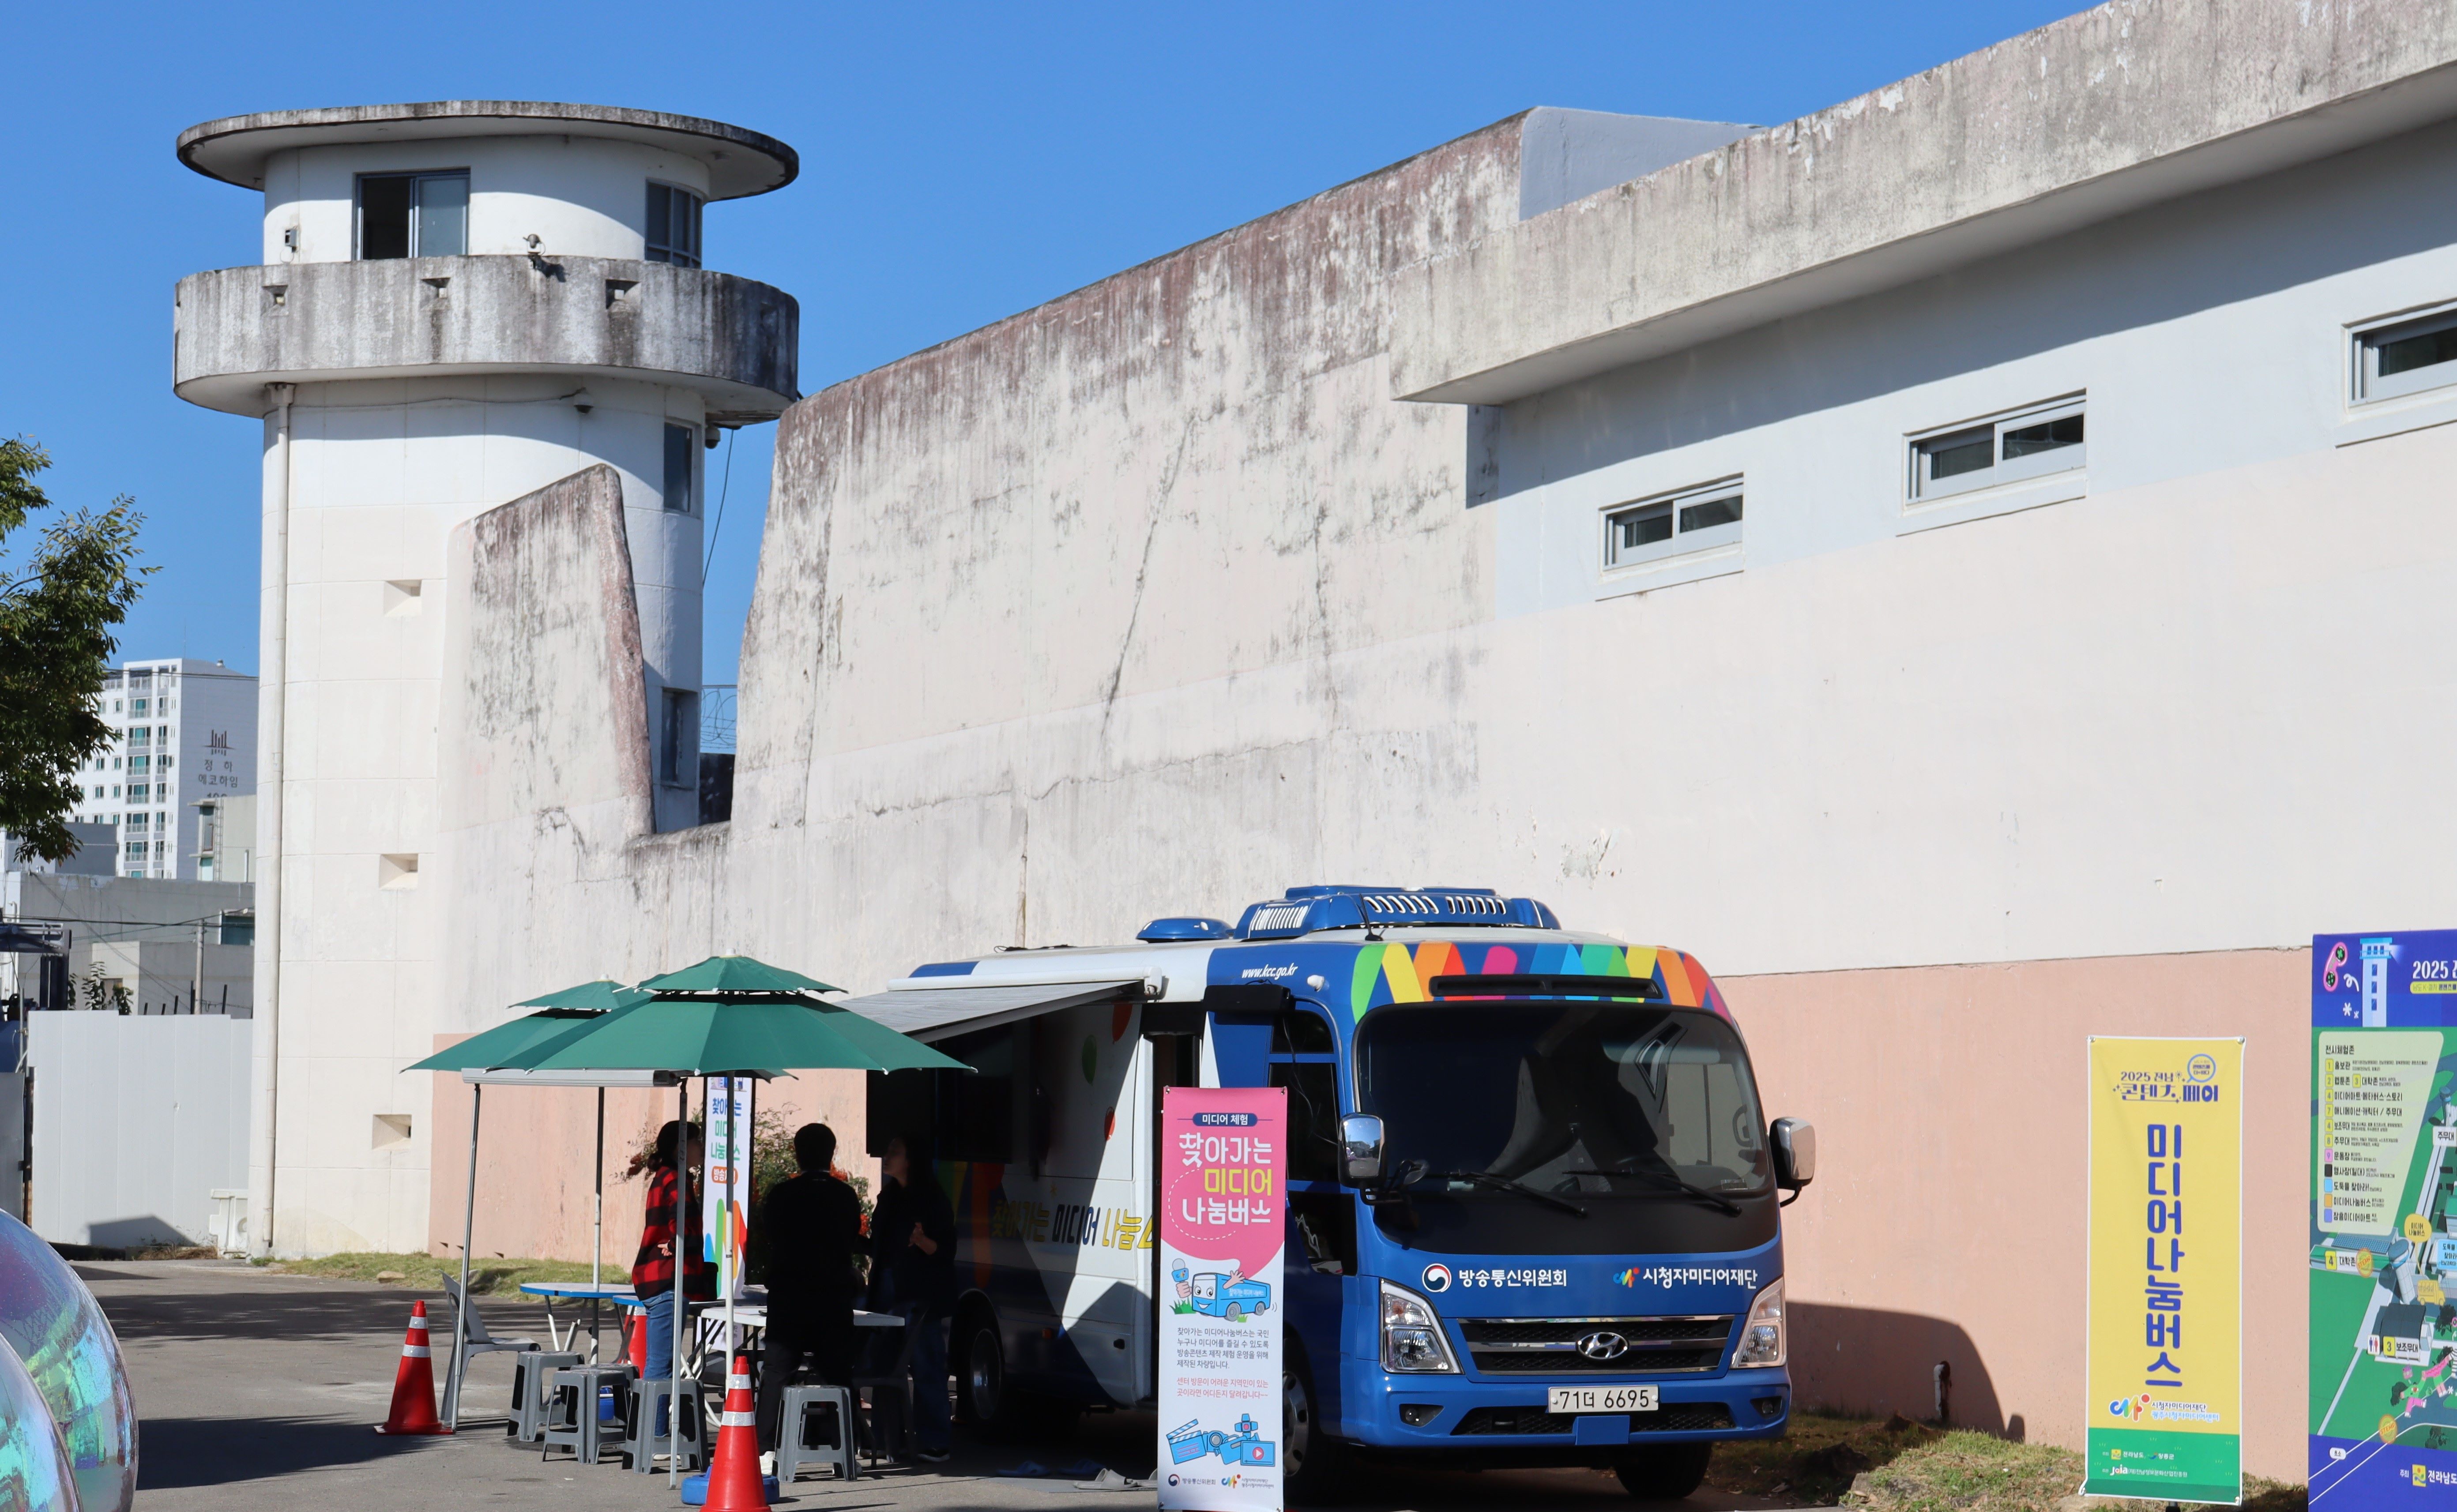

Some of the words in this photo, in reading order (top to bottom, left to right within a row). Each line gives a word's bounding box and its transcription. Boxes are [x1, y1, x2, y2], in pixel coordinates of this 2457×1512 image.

[199, 774, 237, 788] 에코하임
[1242, 963, 1298, 980] www.kcc.go.kr
[2412, 960, 2448, 979] 2025
[2325, 1045, 2355, 1055] 전시체험존
[2335, 1061, 2350, 1070] 홍보관
[2121, 1071, 2151, 1082] 2025
[2154, 1072, 2173, 1082] 전남
[2362, 1076, 2378, 1086] 대학존
[2121, 1083, 2177, 1102] 콘텐츠
[2182, 1084, 2218, 1102] 페어
[712, 1097, 742, 1117] 찾아는
[2386, 1108, 2402, 1116] 주무대
[1202, 1114, 1228, 1125] 미디어
[1230, 1114, 1248, 1125] 체험
[2334, 1121, 2350, 1130] 보조무대
[2334, 1137, 2350, 1145] 주무대
[2437, 1131, 2454, 1141] 주무대
[711, 1142, 741, 1161] 나눔스
[1179, 1132, 1272, 1168] 찾아가는
[2334, 1151, 2350, 1161] 운동장
[2334, 1166, 2365, 1176] 행사장(일대)
[1204, 1168, 1272, 1196] 미디어
[2334, 1182, 2349, 1191] 도둑을
[2352, 1182, 2370, 1192] 찾아라!
[2333, 1196, 2371, 1207] 미디어나눔버스
[1182, 1197, 1271, 1226] 나눔버스
[2333, 1212, 2371, 1222] 장흥미디어아트
[1052, 1204, 1100, 1246] 미디어
[2145, 1124, 2185, 1387] 미디어나눔버스
[2329, 1256, 2333, 1266] 4
[2339, 1256, 2355, 1267] 대학존
[1459, 1269, 1566, 1287] 방송통신위원회
[1643, 1267, 1757, 1289] 시청자미디어재단
[1178, 1327, 1203, 1336] 찾아가는
[1204, 1328, 1255, 1338] 미디어나눔버스는
[1257, 1330, 1269, 1338] 국민
[1199, 1339, 1224, 1347] 미디어를
[1227, 1339, 1239, 1348] 즐길
[1250, 1340, 1269, 1349] 있도록
[2387, 1342, 2391, 1352] 3
[2396, 1342, 2418, 1352] 보조무대
[1177, 1349, 1208, 1358] 방송콘텐츠
[1223, 1350, 1234, 1359] 체험
[1236, 1350, 1254, 1359] 운영을
[1197, 1360, 1230, 1369] 차량입니다.
[1177, 1377, 1189, 1386] 센터
[1191, 1377, 1209, 1386] 방문이
[1211, 1378, 1229, 1387] 어려운
[1230, 1379, 1255, 1388] 지역민이
[1257, 1380, 1269, 1388] 있는
[1177, 1388, 1201, 1397] 곳이라면
[1203, 1389, 1227, 1398] 어디든지
[1560, 1391, 1594, 1409] 71더
[1604, 1390, 1649, 1408] 6695
[2152, 1402, 2207, 1412] 시청자미디어재단
[2152, 1411, 2219, 1422] 광주시청자미디어센터
[2380, 1422, 2395, 1435] STEMP
[2400, 1469, 2409, 1478] 주최
[2428, 1470, 2457, 1485] 전라남도
